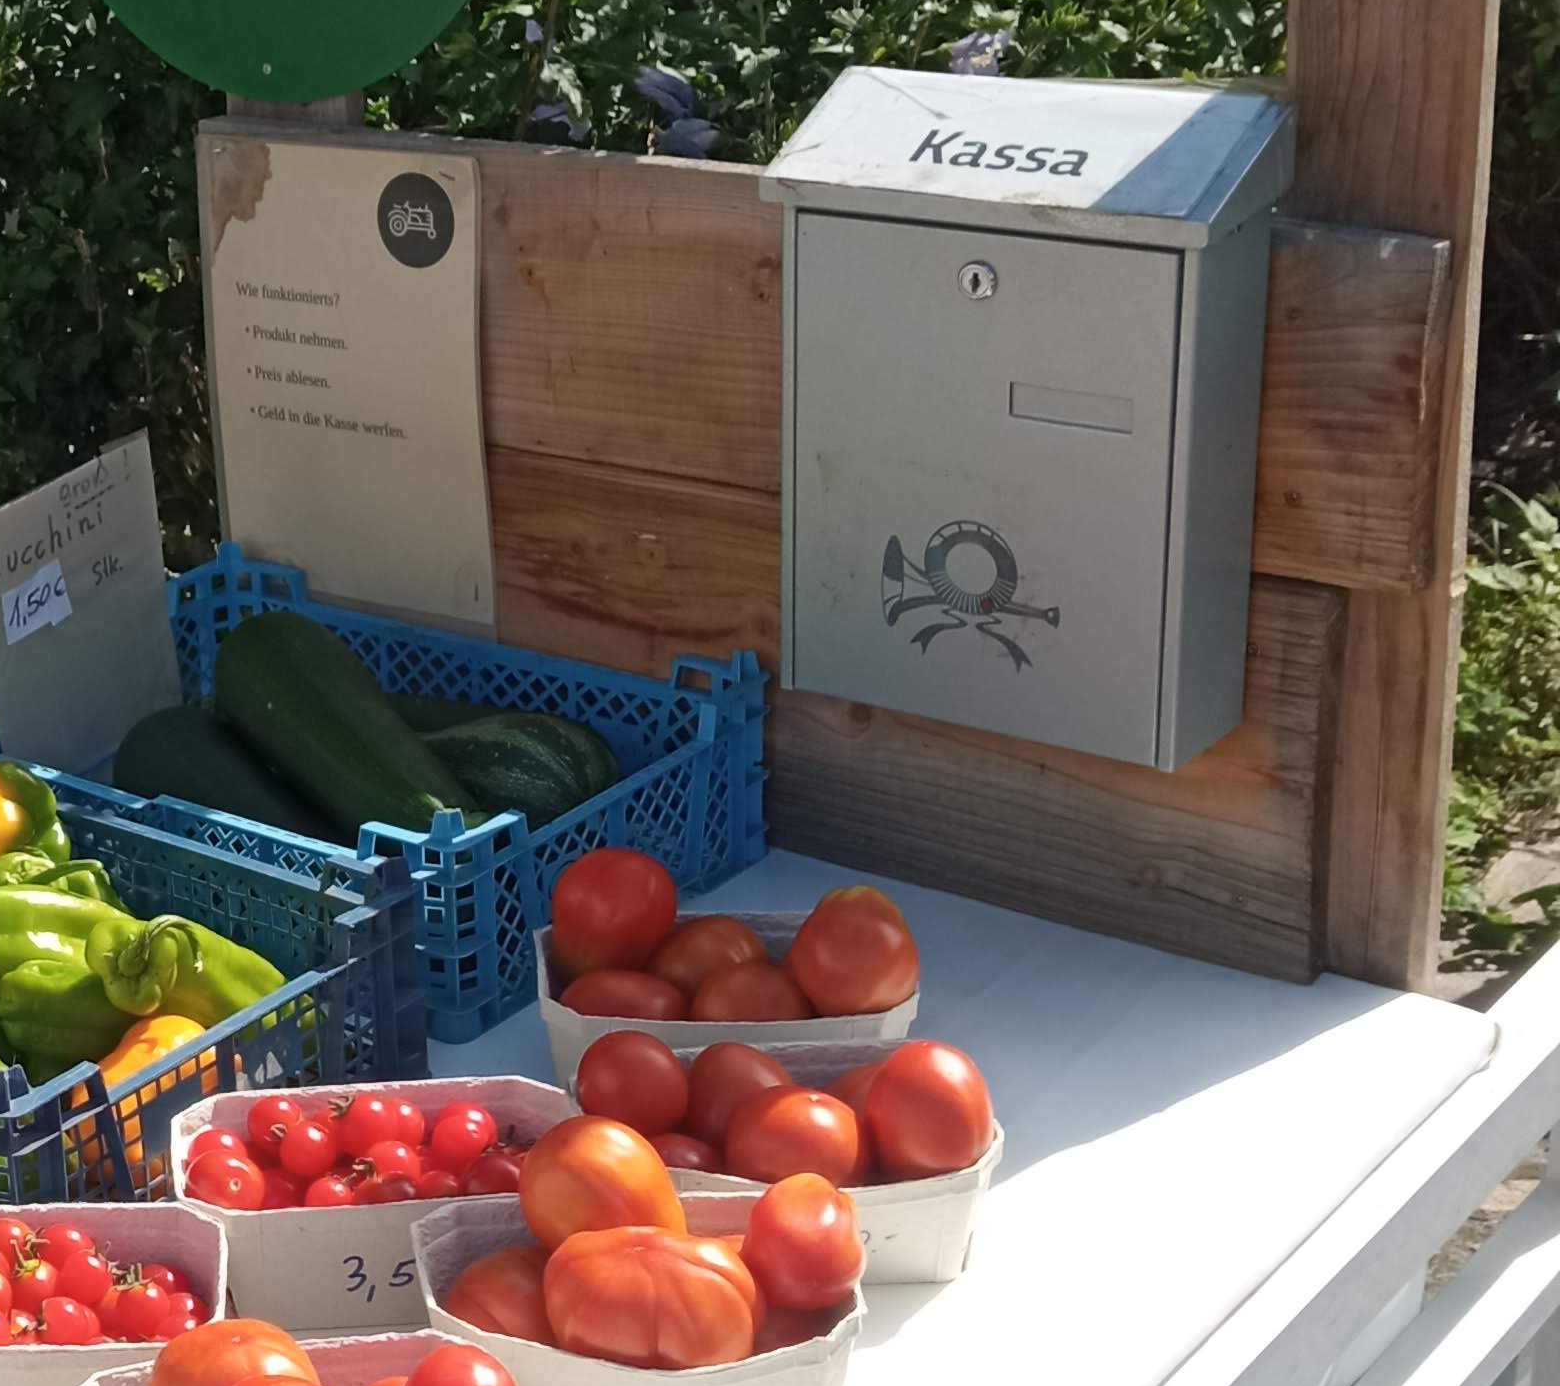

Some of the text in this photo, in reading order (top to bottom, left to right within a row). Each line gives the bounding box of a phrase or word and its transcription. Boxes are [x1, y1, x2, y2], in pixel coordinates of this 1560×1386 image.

[909, 129, 1090, 178] Kassa
[235, 281, 340, 308] Wie funktionierts?
[252, 325, 349, 351] Produkt nehmen.
[254, 365, 332, 389] Preis ablesen.
[257, 405, 408, 440] Geld in die Kasse werfen.
